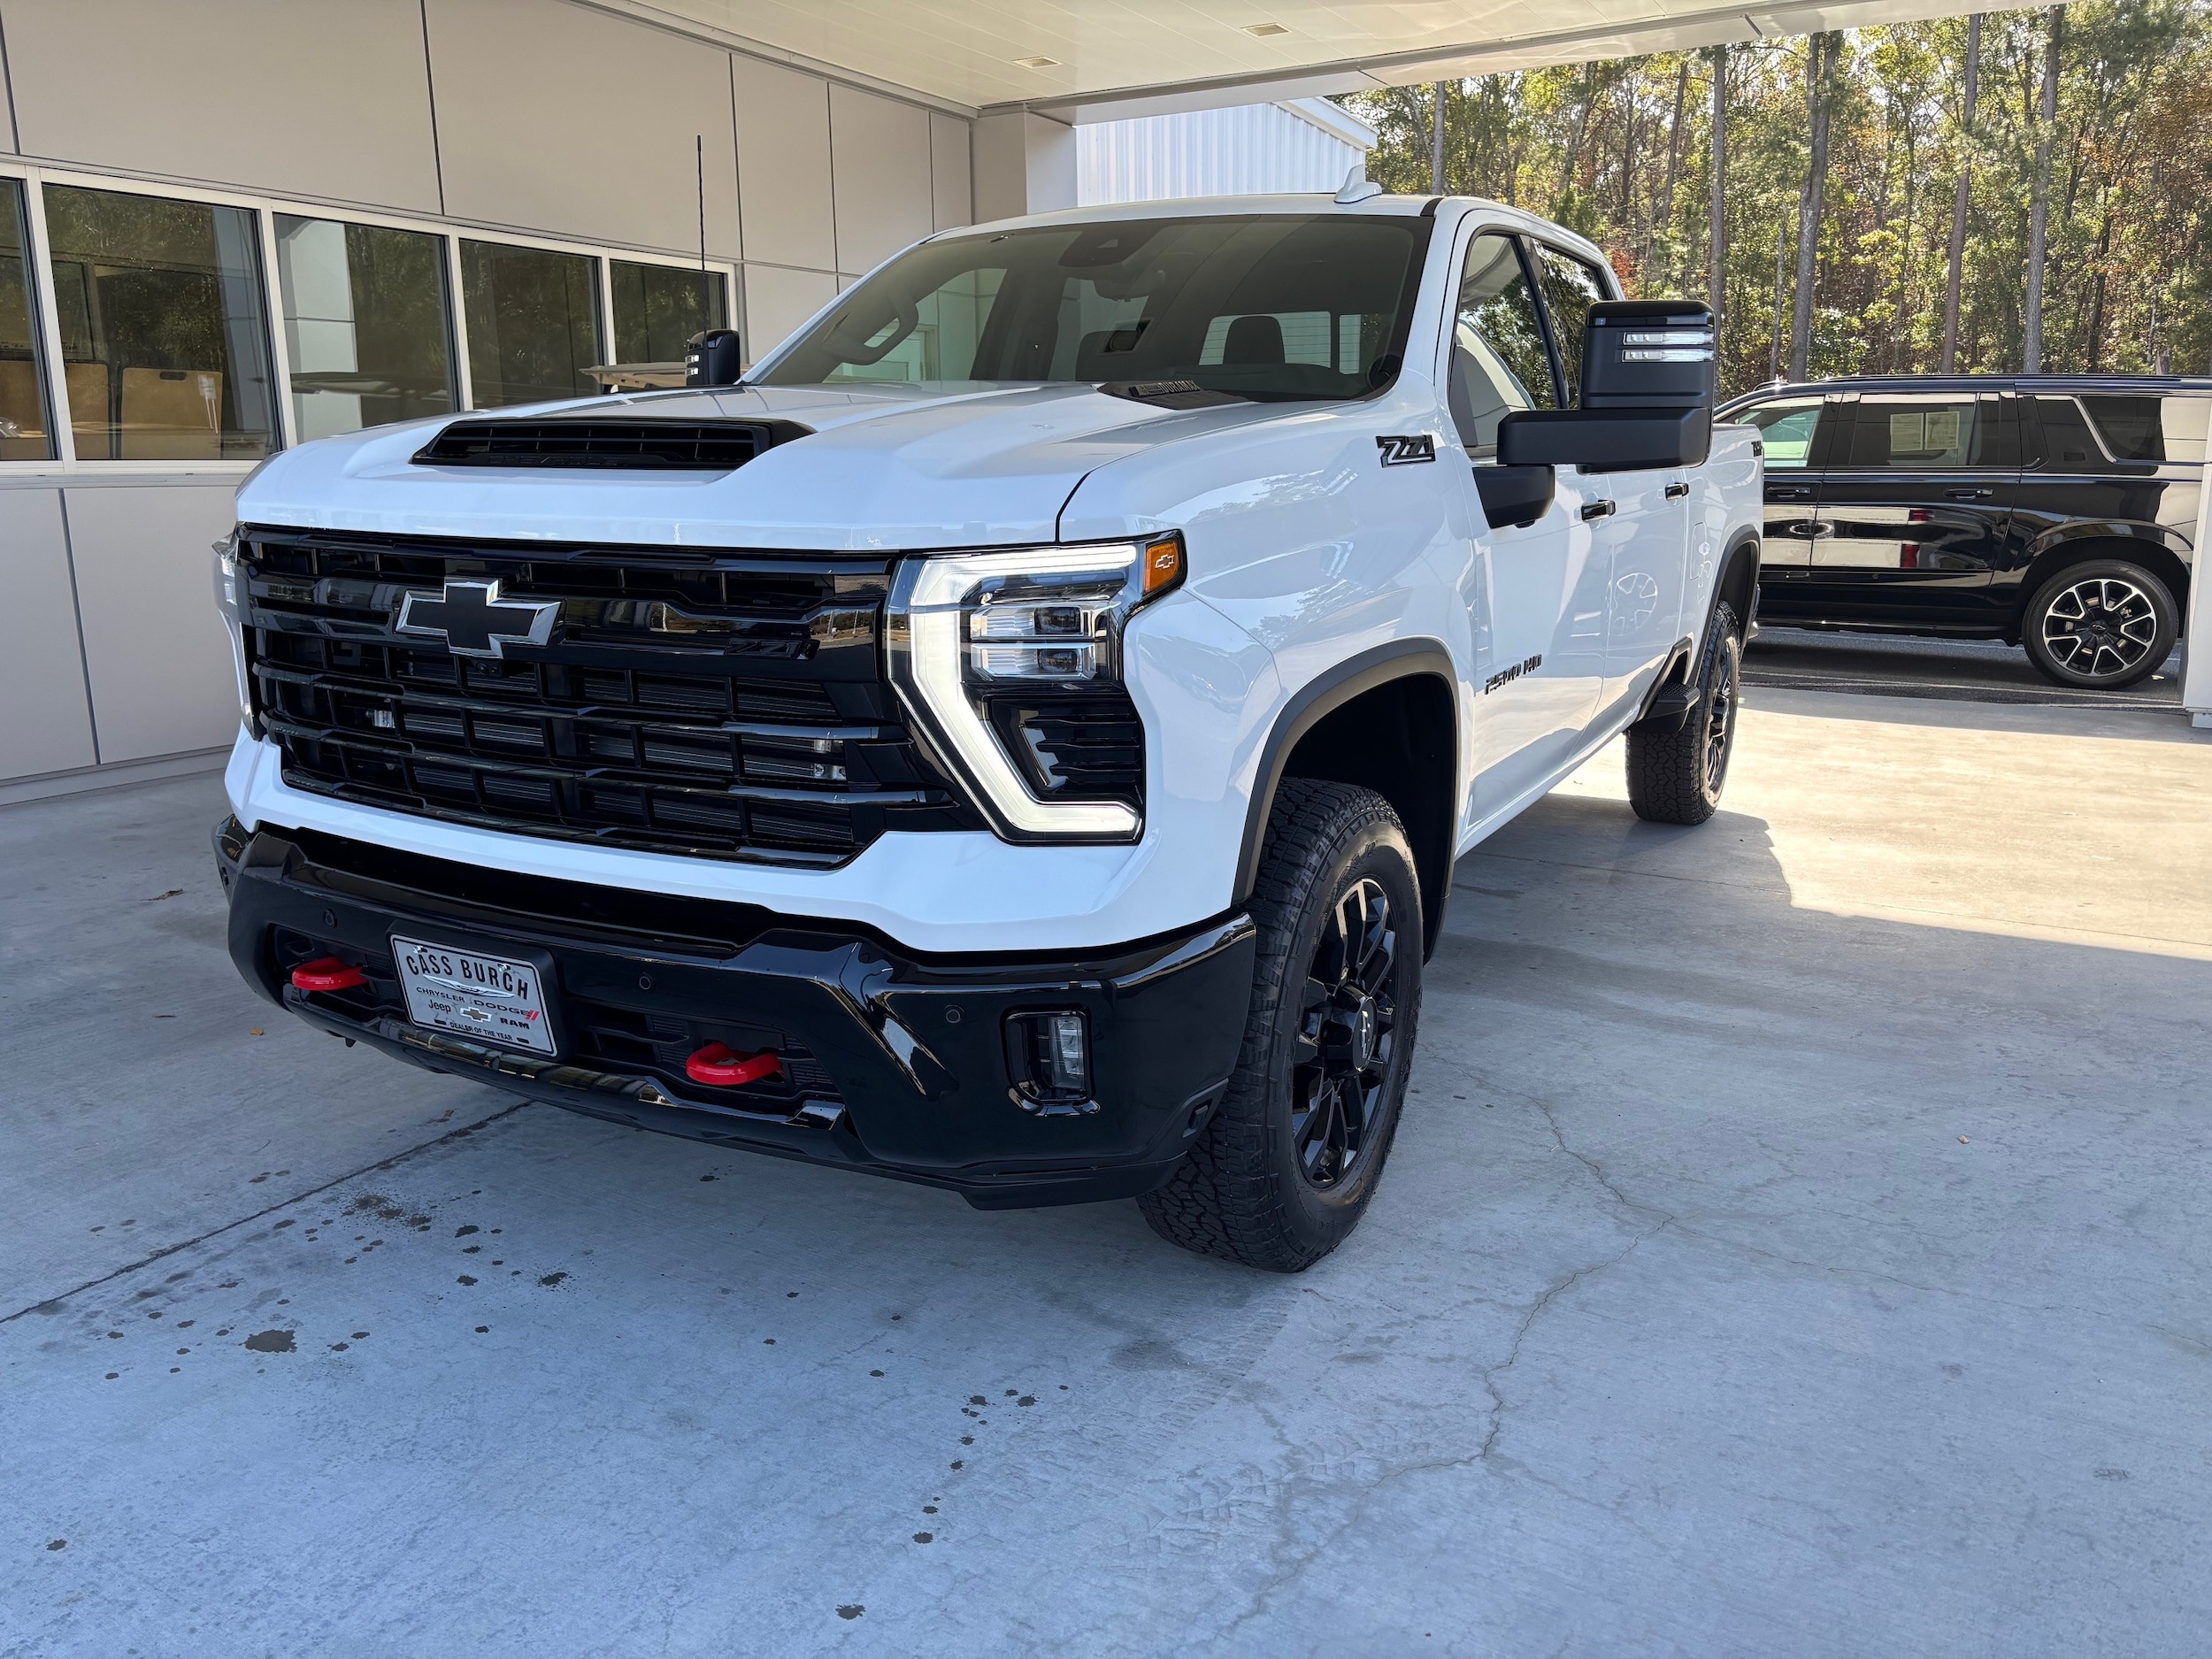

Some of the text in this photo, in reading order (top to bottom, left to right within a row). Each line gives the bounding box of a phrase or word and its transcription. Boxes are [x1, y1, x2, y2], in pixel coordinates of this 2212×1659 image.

[1376, 434, 1436, 468] Z71
[406, 954, 528, 1000] CASS BURCH
[416, 987, 465, 1002] CHRYSLER
[428, 999, 451, 1014] Jeep
[473, 999, 529, 1016] DODGE
[449, 1022, 473, 1033] DEALER
[497, 1033, 513, 1041] YEAR
[500, 1017, 530, 1030] RAM
